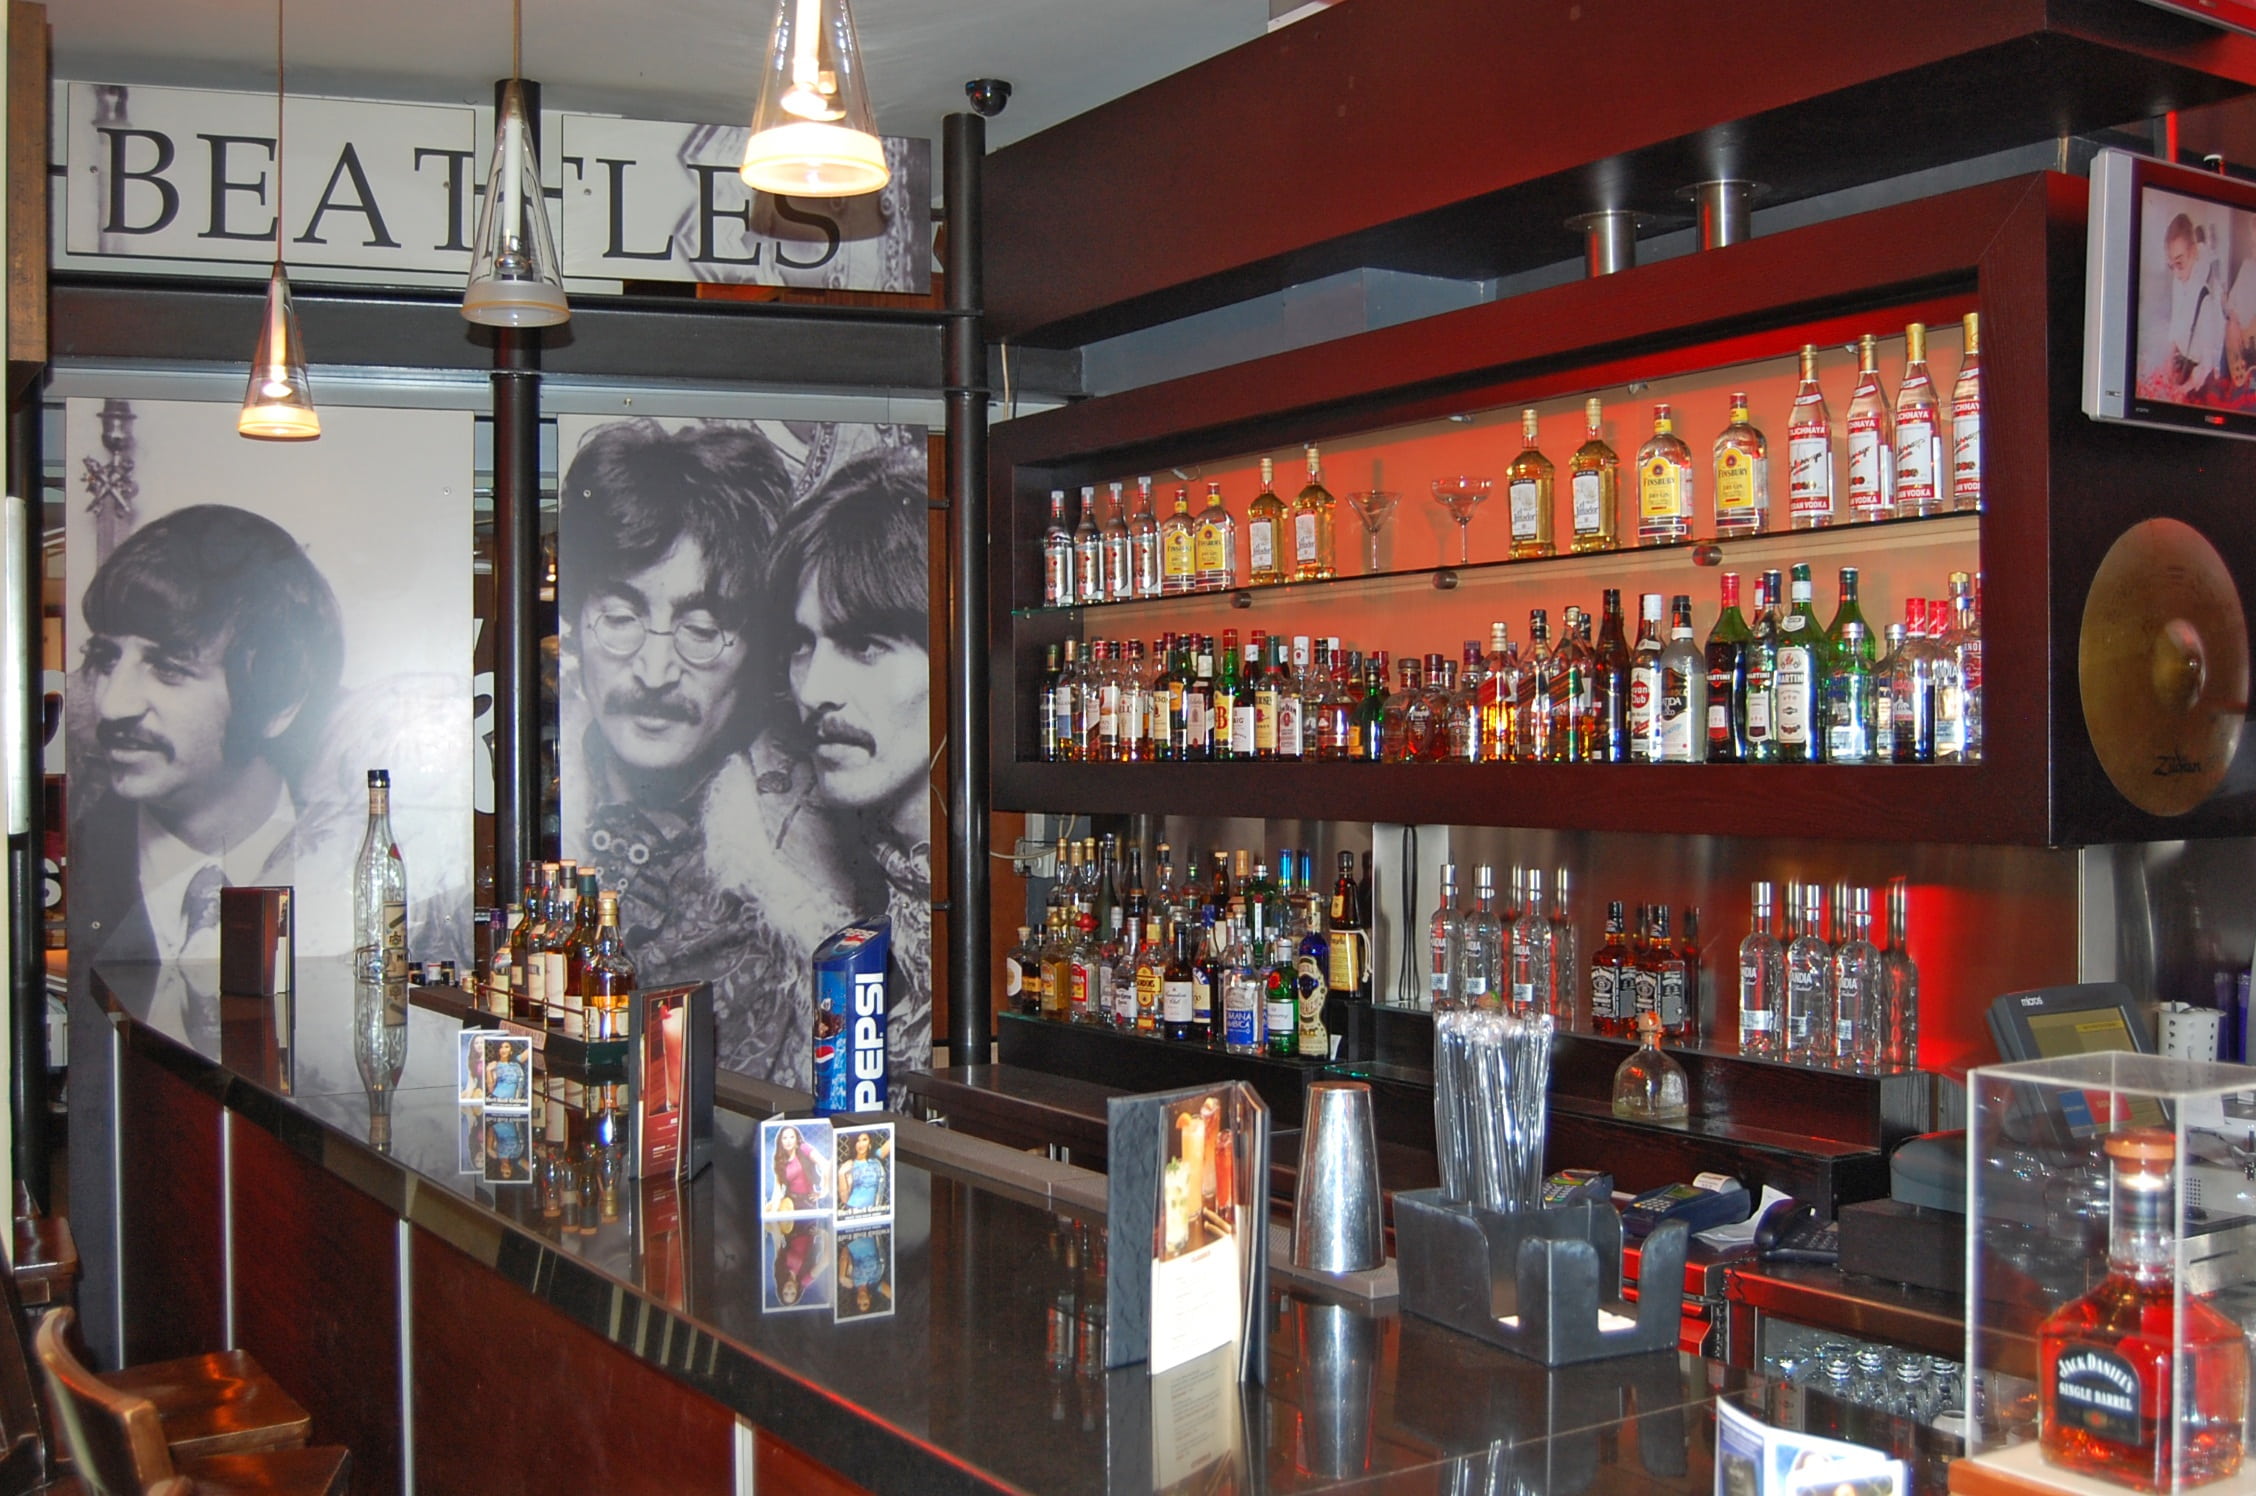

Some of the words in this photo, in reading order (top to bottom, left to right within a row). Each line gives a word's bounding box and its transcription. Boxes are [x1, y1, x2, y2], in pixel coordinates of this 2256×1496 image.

[98, 126, 844, 271] BEATLES
[1718, 467, 1748, 478] FINSBURY
[1643, 476, 1675, 486] FINSBURY
[1907, 488, 1931, 498] VODKA
[1804, 500, 1828, 510] VODKA
[1855, 496, 1877, 505] VODKA
[855, 972, 884, 1112] PEPSI
[2058, 1355, 2087, 1379] JACK
[2086, 1352, 2133, 1394] DANIEL'S
[2058, 1381, 2093, 1402] SINGLE
[2093, 1389, 2133, 1412] BARREL
